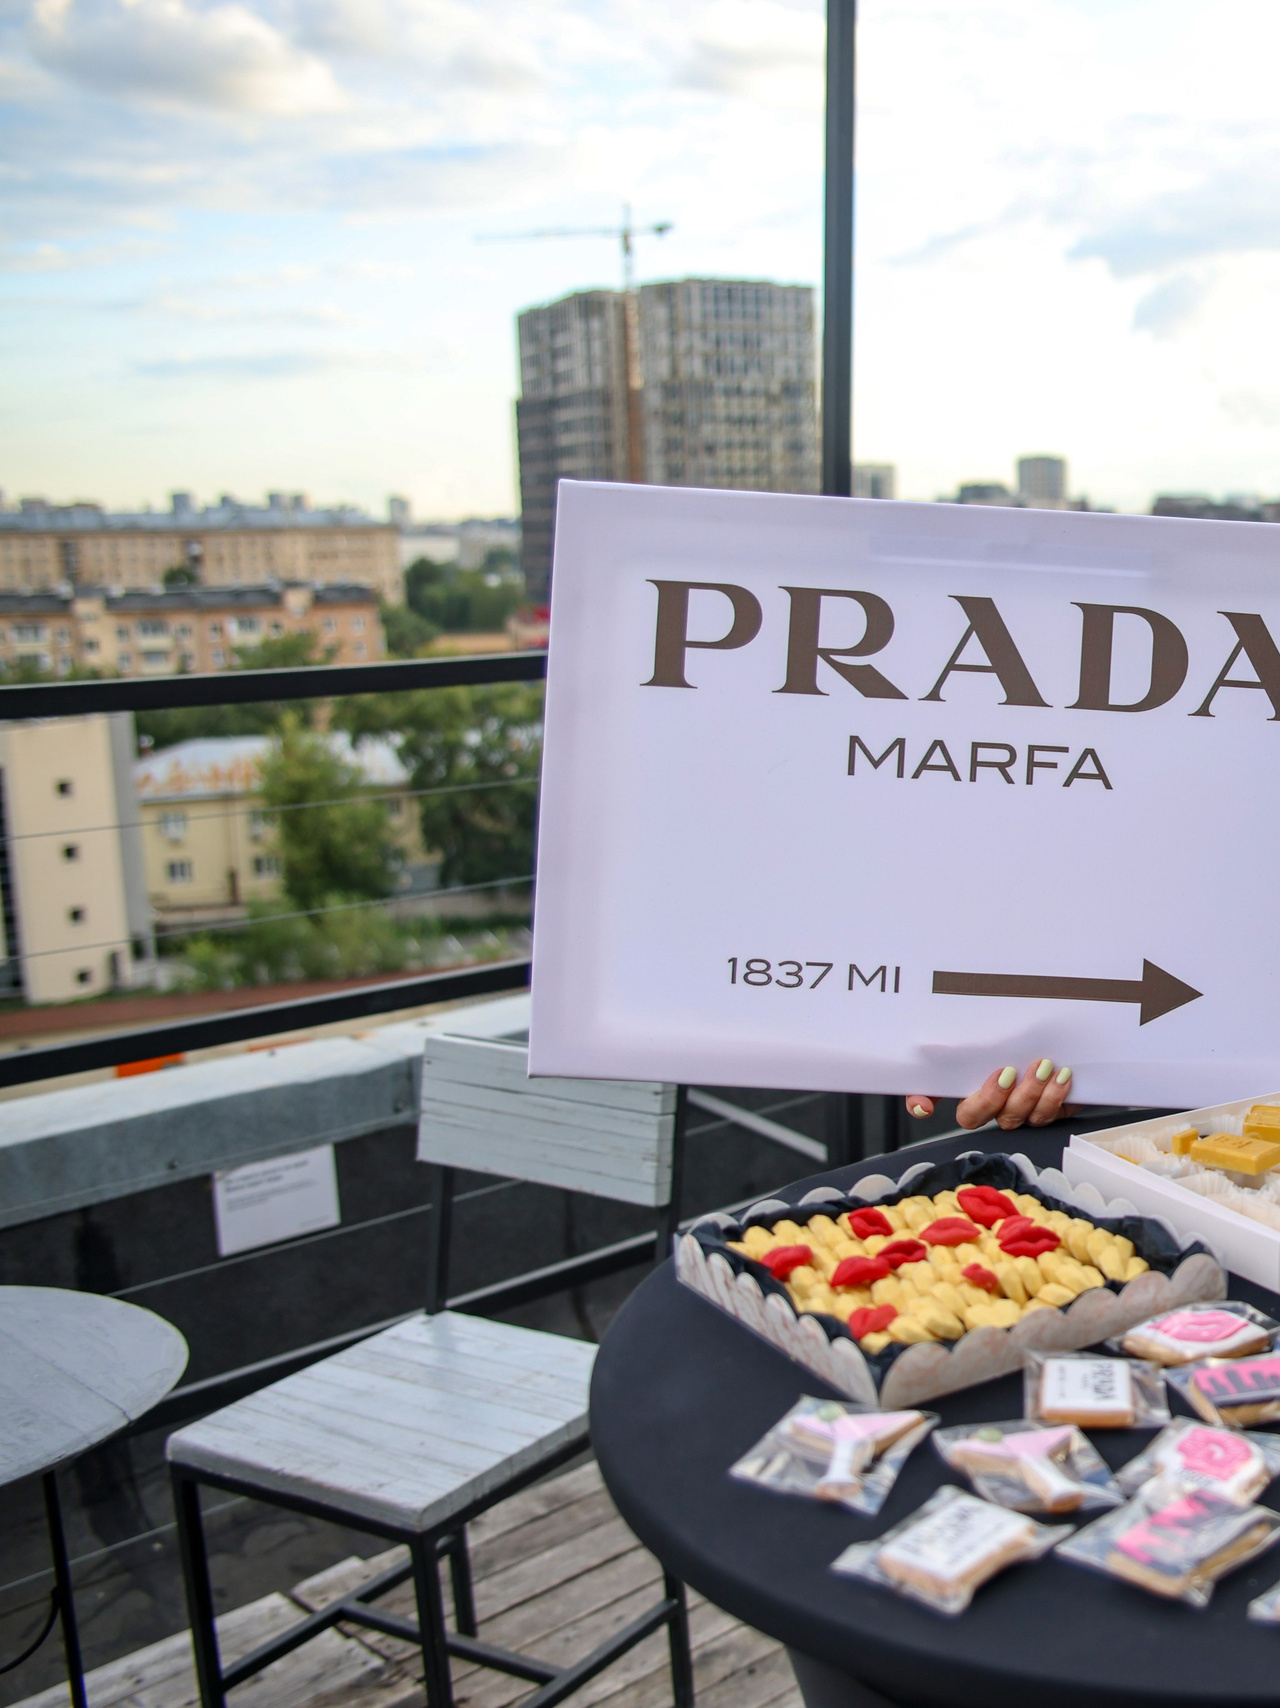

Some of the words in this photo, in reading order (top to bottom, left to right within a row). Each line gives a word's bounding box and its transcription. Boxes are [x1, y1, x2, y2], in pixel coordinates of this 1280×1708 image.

[848, 735, 1113, 790] MARFA
[728, 957, 833, 991] 1837
[848, 963, 901, 994] MI
